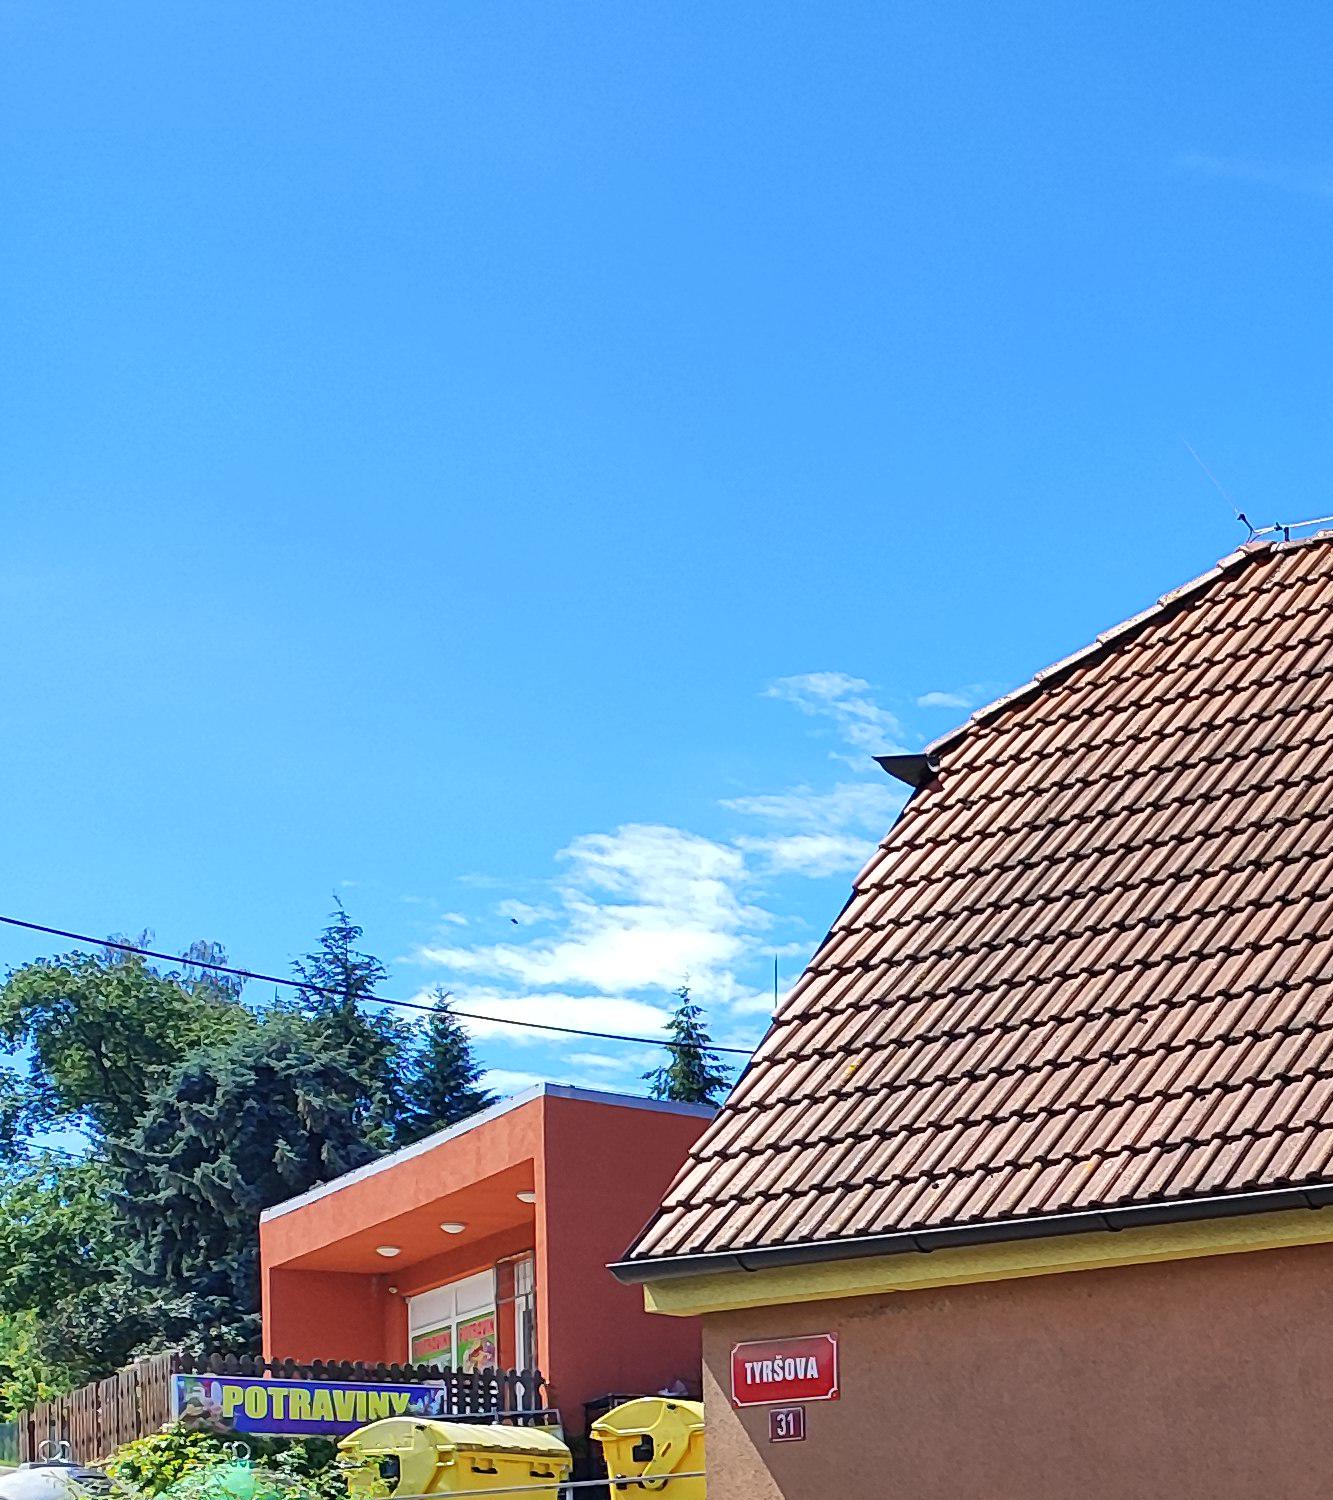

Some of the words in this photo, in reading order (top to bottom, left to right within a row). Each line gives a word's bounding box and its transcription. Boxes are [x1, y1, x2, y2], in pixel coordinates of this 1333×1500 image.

[744, 1355, 819, 1385] TYRŠOVA
[222, 1385, 411, 1422] POTRAVINY
[776, 1413, 795, 1436] 31
